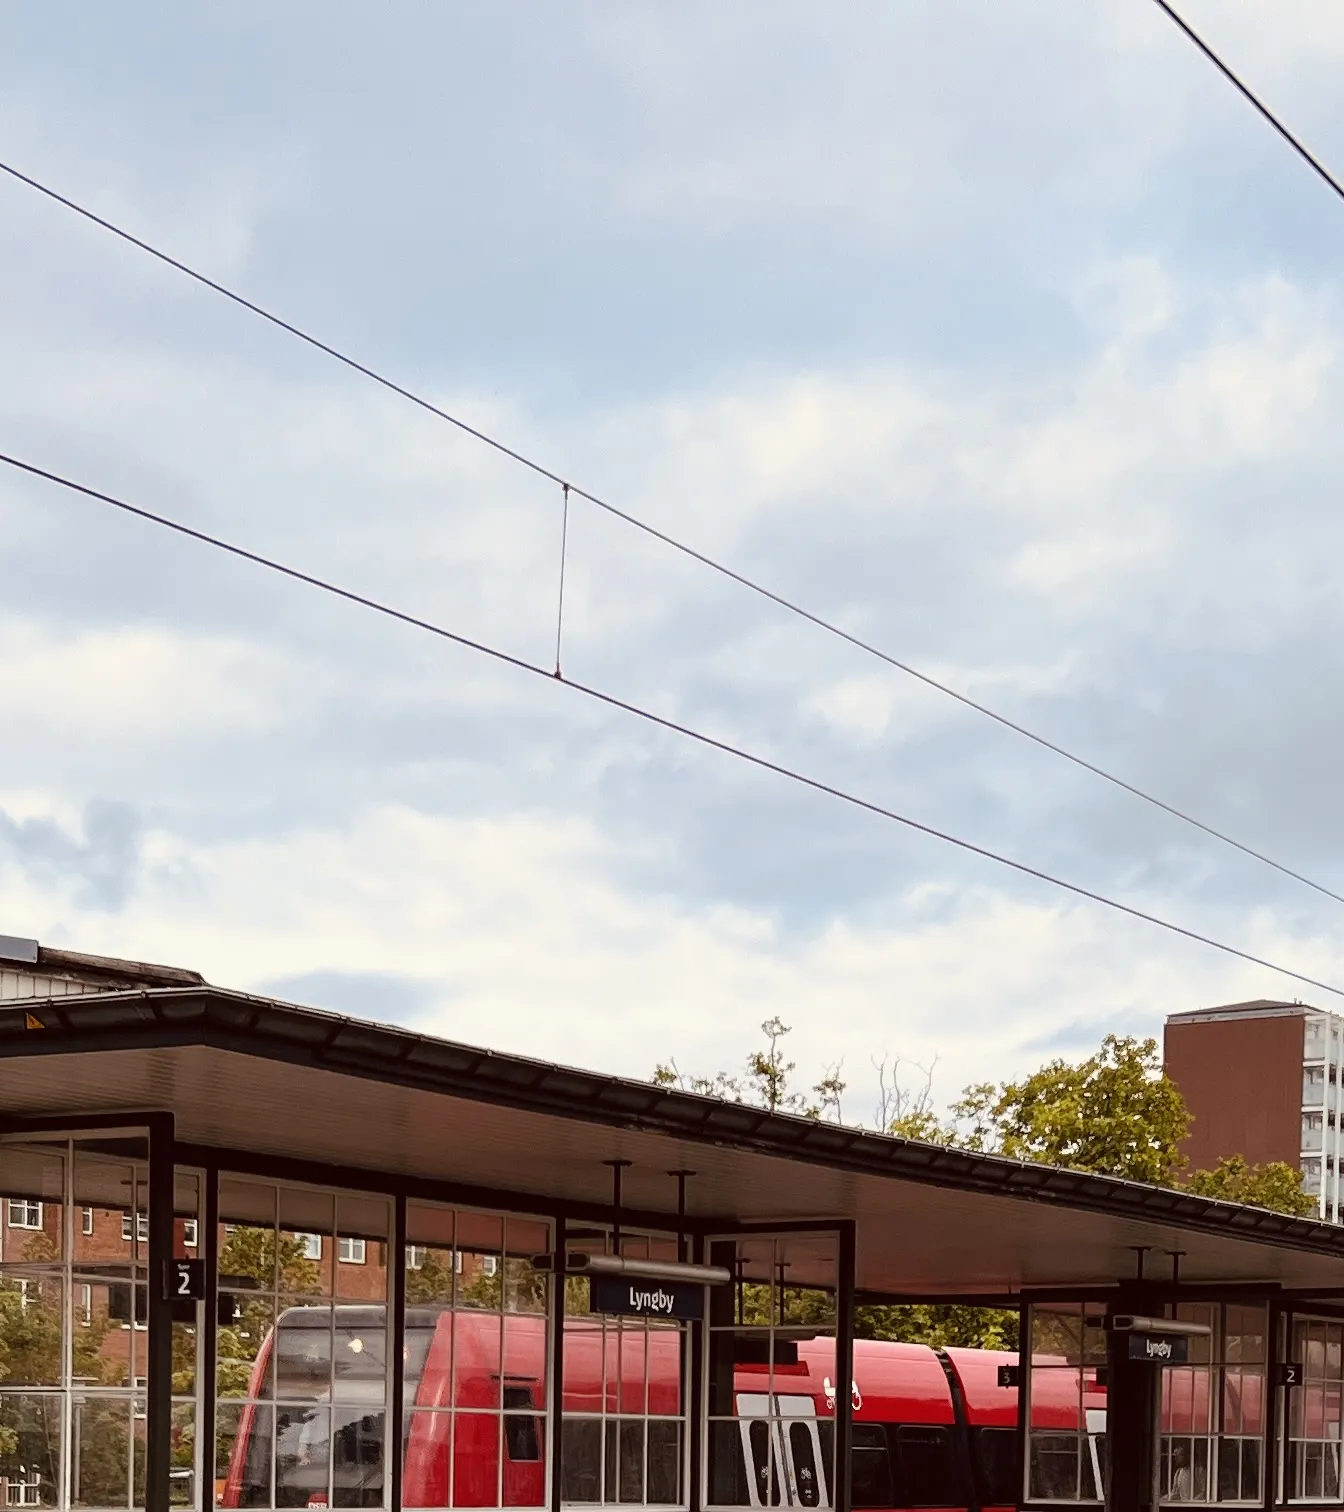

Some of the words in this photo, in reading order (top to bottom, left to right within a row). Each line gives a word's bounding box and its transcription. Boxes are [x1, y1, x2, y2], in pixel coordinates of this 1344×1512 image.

[178, 1272, 190, 1294] 2
[629, 1286, 674, 1313] Lyngby
[1146, 1339, 1172, 1358] Lyngby
[1286, 1369, 1296, 1382] 2
